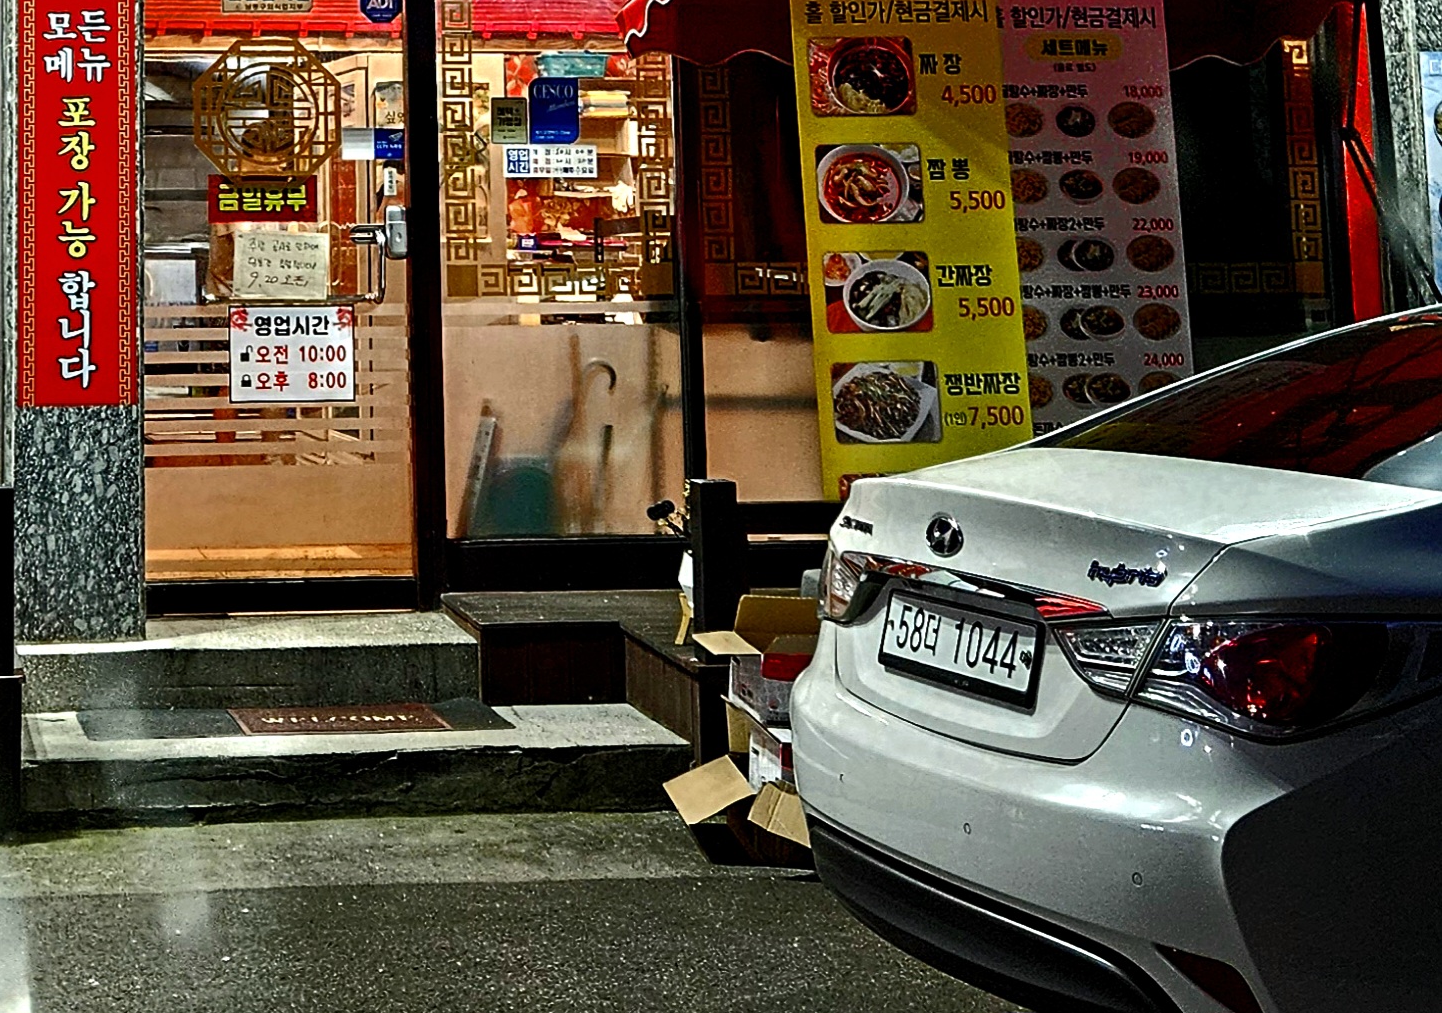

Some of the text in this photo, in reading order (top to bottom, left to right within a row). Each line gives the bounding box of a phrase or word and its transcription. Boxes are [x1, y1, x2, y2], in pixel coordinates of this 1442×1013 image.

[805, 0, 823, 24] 홀
[829, 0, 988, 24] 할인가/현금결제시
[1011, 6, 1156, 29] 할인가/현금결제시
[42, 9, 112, 44] 모든
[1041, 40, 1109, 57] 세트메뉴
[43, 47, 113, 84] 메뉴
[533, 83, 574, 99] CESCO
[941, 84, 998, 107] 4,500
[1123, 85, 1164, 99] 18,000
[508, 149, 529, 160] 영업
[1128, 151, 1169, 166] 19,000
[508, 162, 529, 173] 시간
[949, 189, 1006, 214] 5,500
[1014, 217, 1174, 232] 탕수+짜장2+만두 22,000
[57, 96, 98, 391] 포장 가능 합니다
[936, 264, 993, 288] 간짜장
[1021, 284, 1179, 300] 탕수+짜장+짬뽕+만두 23,000
[958, 296, 1015, 321] 5,500
[254, 315, 330, 337] 영업시간
[255, 344, 347, 364] 오전 10:00
[1143, 353, 1184, 368] 24,000
[255, 370, 347, 392] 오후 8:00
[944, 372, 1021, 396] 쟁반짜장
[967, 405, 1025, 430] 7,500
[896, 605, 1020, 679] 58더 1044
